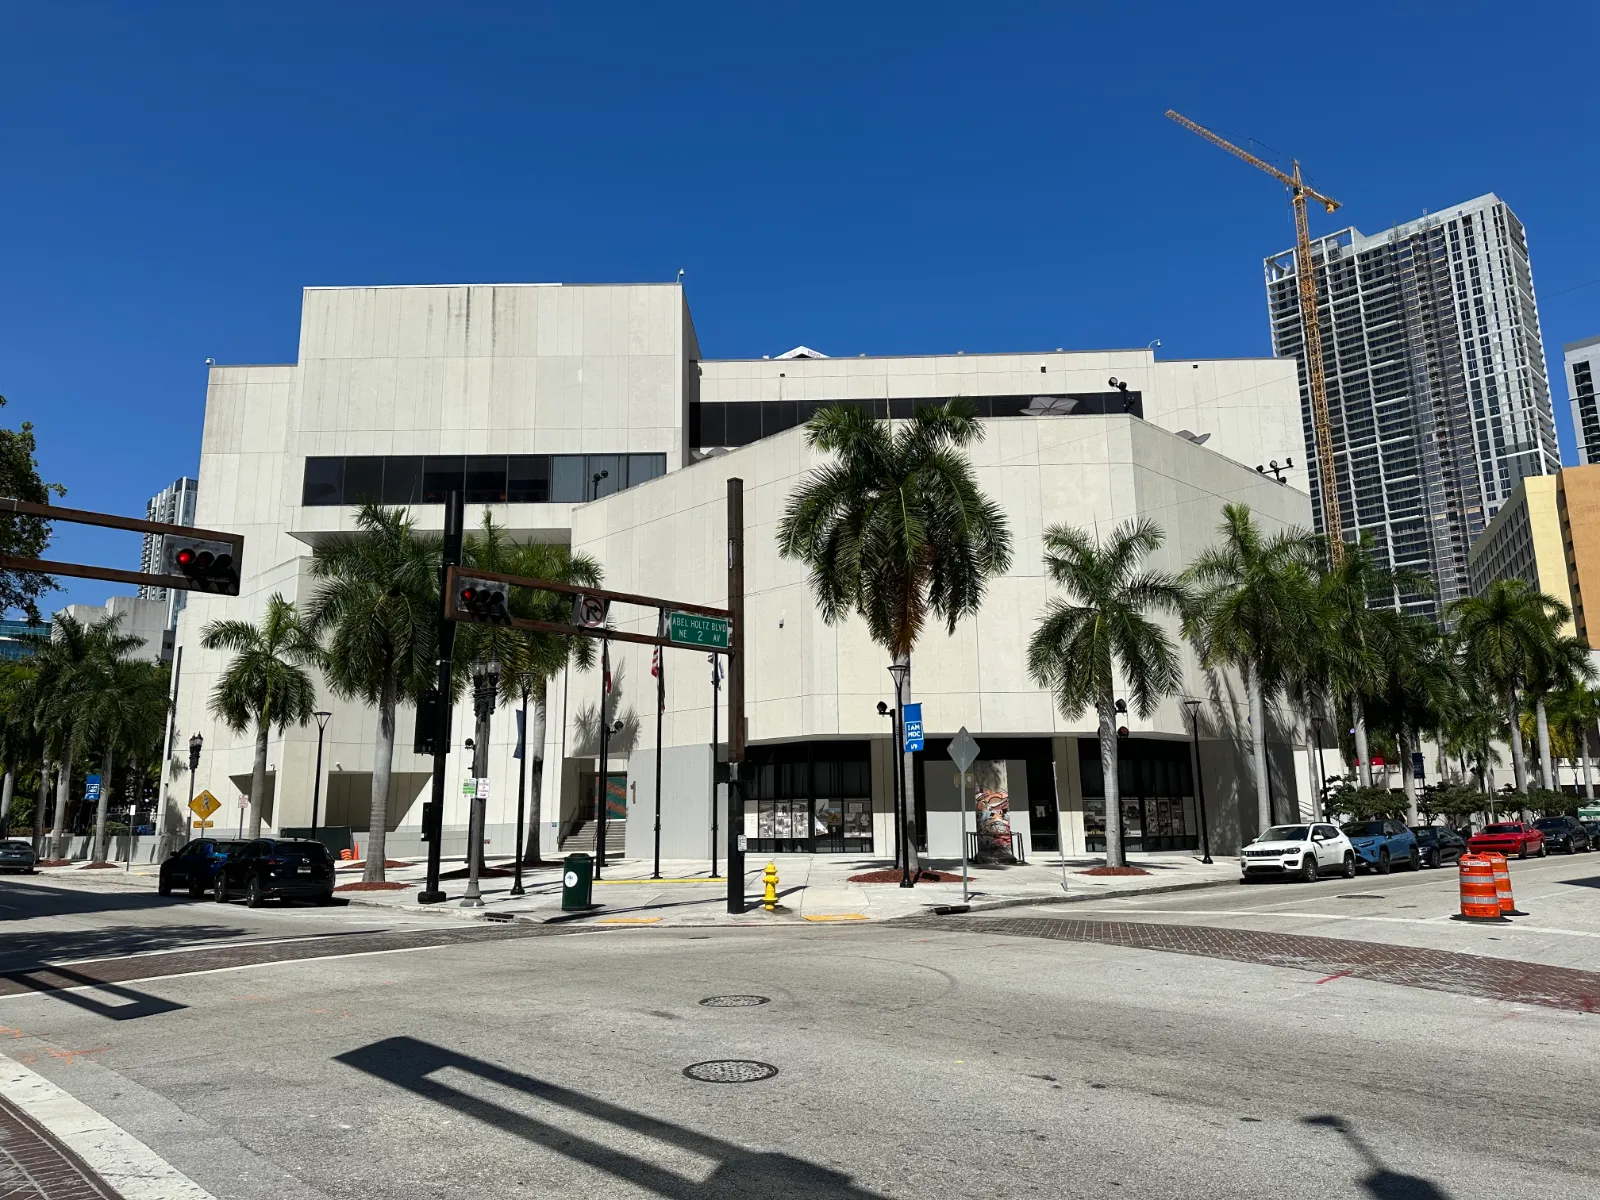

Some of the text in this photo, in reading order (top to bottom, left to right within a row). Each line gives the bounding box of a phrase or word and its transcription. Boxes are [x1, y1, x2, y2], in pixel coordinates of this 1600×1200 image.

[672, 617, 726, 632] ABEL HOLTZ BLVD
[678, 630, 688, 638] NE
[697, 631, 703, 641] 2
